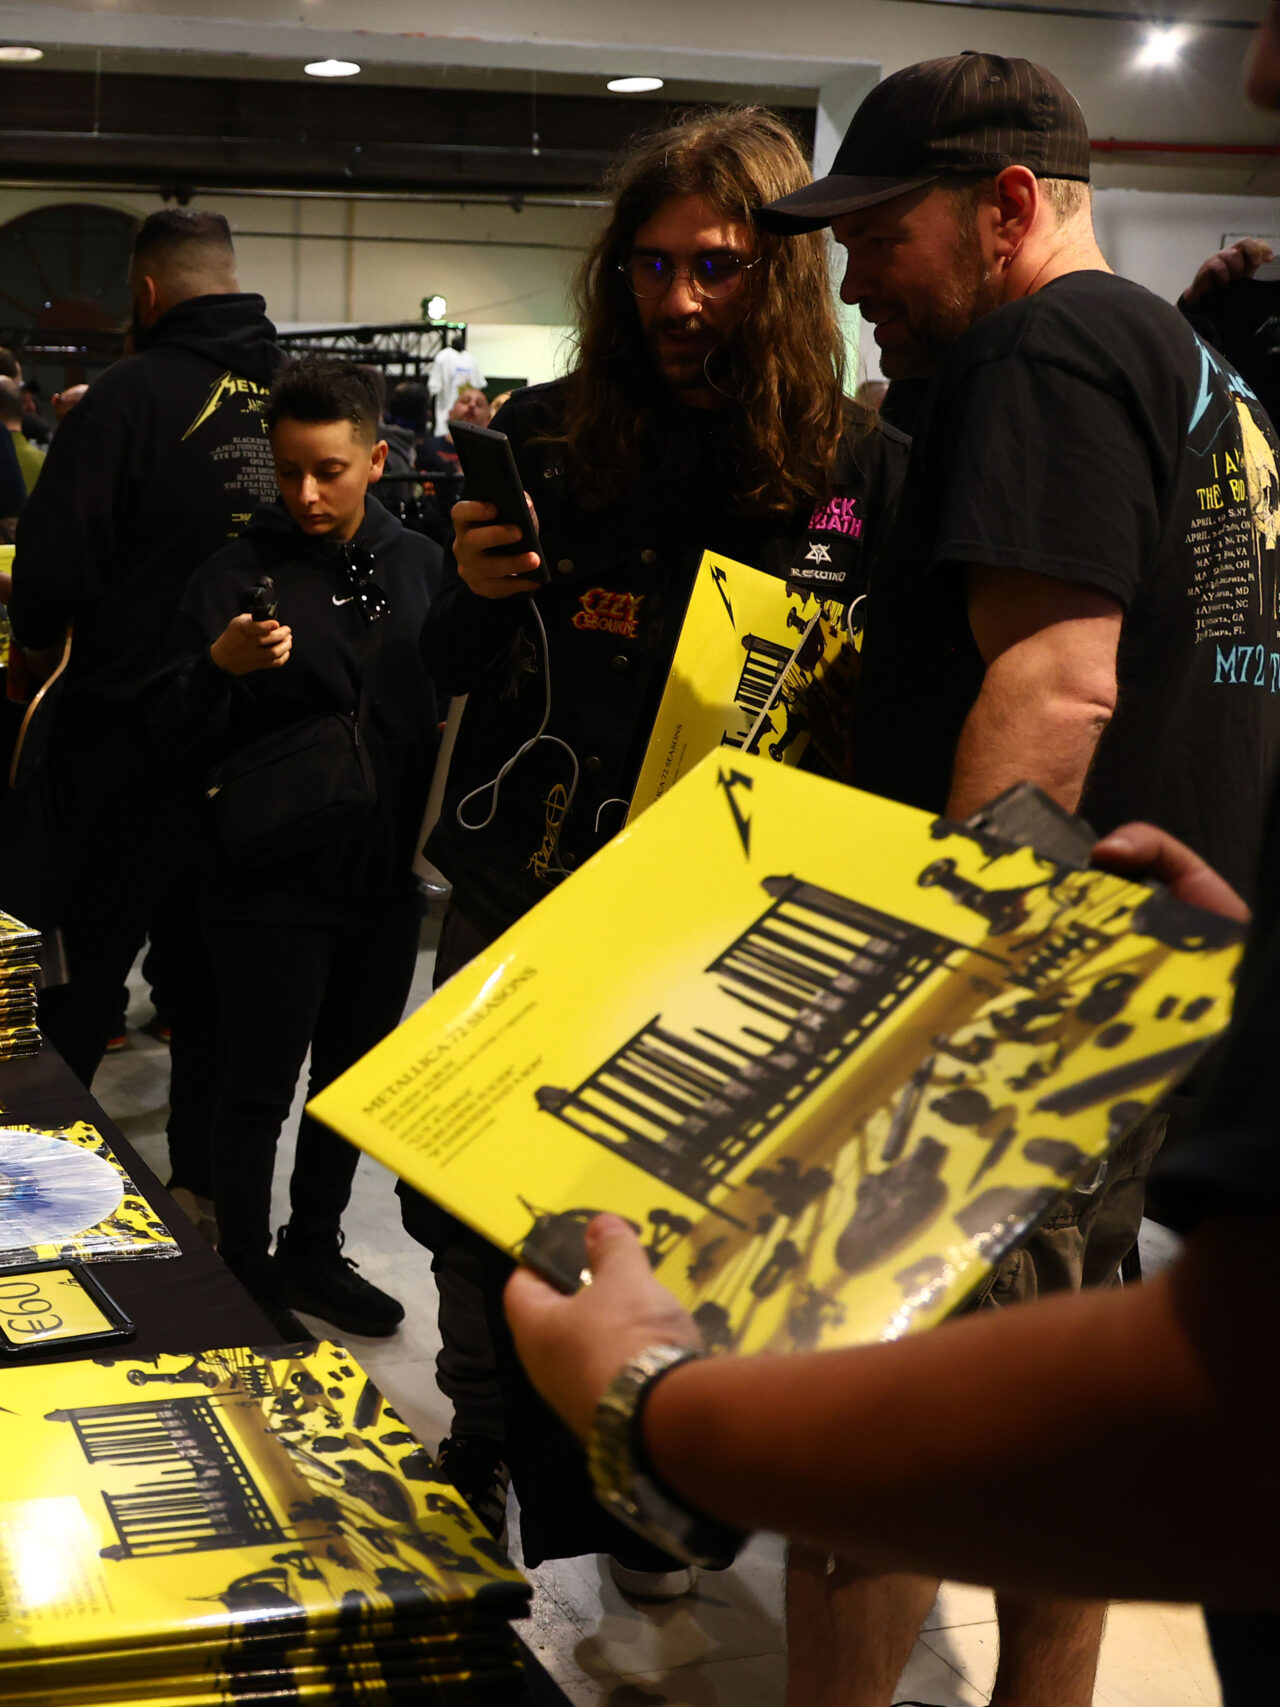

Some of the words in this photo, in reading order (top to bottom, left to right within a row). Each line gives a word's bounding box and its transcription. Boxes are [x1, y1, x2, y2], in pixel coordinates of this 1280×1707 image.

[1214, 644, 1265, 687] M72
[665, 723, 683, 767] SEASONS
[362, 1044, 451, 1114] METALLICA
